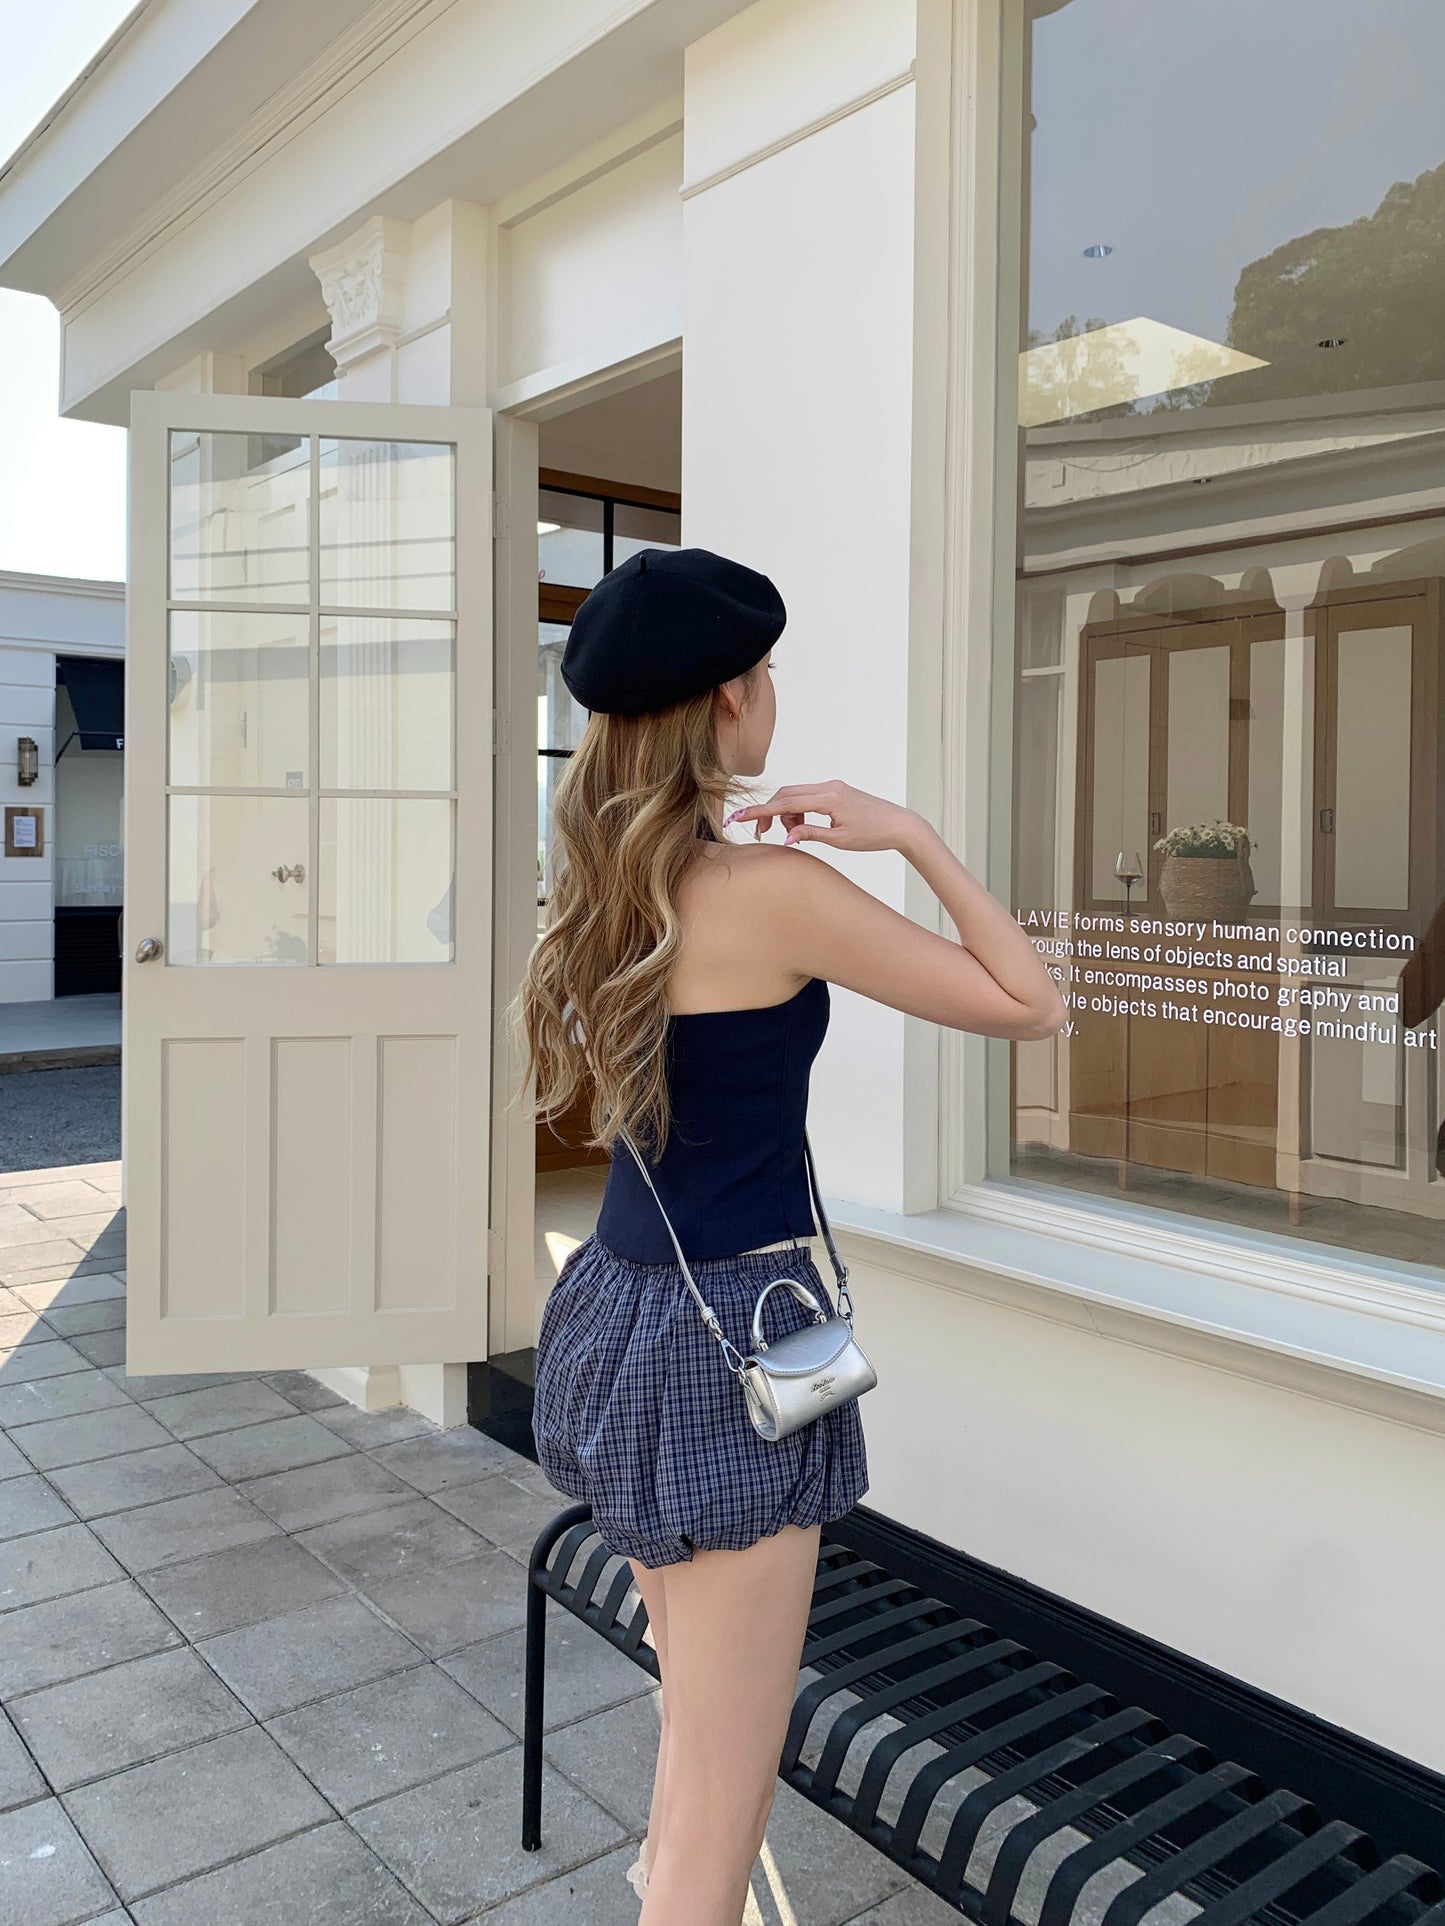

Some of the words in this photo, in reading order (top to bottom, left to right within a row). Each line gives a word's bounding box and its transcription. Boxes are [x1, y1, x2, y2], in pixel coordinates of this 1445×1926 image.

[1017, 908, 1069, 929] LAVIE
[1074, 912, 1125, 933] forms
[1129, 918, 1207, 941] sensory
[1212, 919, 1280, 943] human
[1286, 928, 1415, 952] connection
[1077, 939, 1103, 958] the
[1106, 941, 1141, 961] lens
[1143, 944, 1162, 962] of
[1164, 946, 1234, 969] objects
[1236, 951, 1273, 972] and
[1276, 956, 1348, 979] spatial
[1069, 965, 1081, 983] It
[1084, 970, 1209, 995] encompasses
[1212, 978, 1270, 1001] photo
[1276, 986, 1352, 1015] graphy
[1357, 991, 1399, 1014] and
[1090, 994, 1157, 1018] objects
[1161, 1001, 1199, 1023] that
[1202, 1008, 1312, 1038] encourage
[1316, 1017, 1398, 1046] mindful
[1403, 1027, 1438, 1050] art
